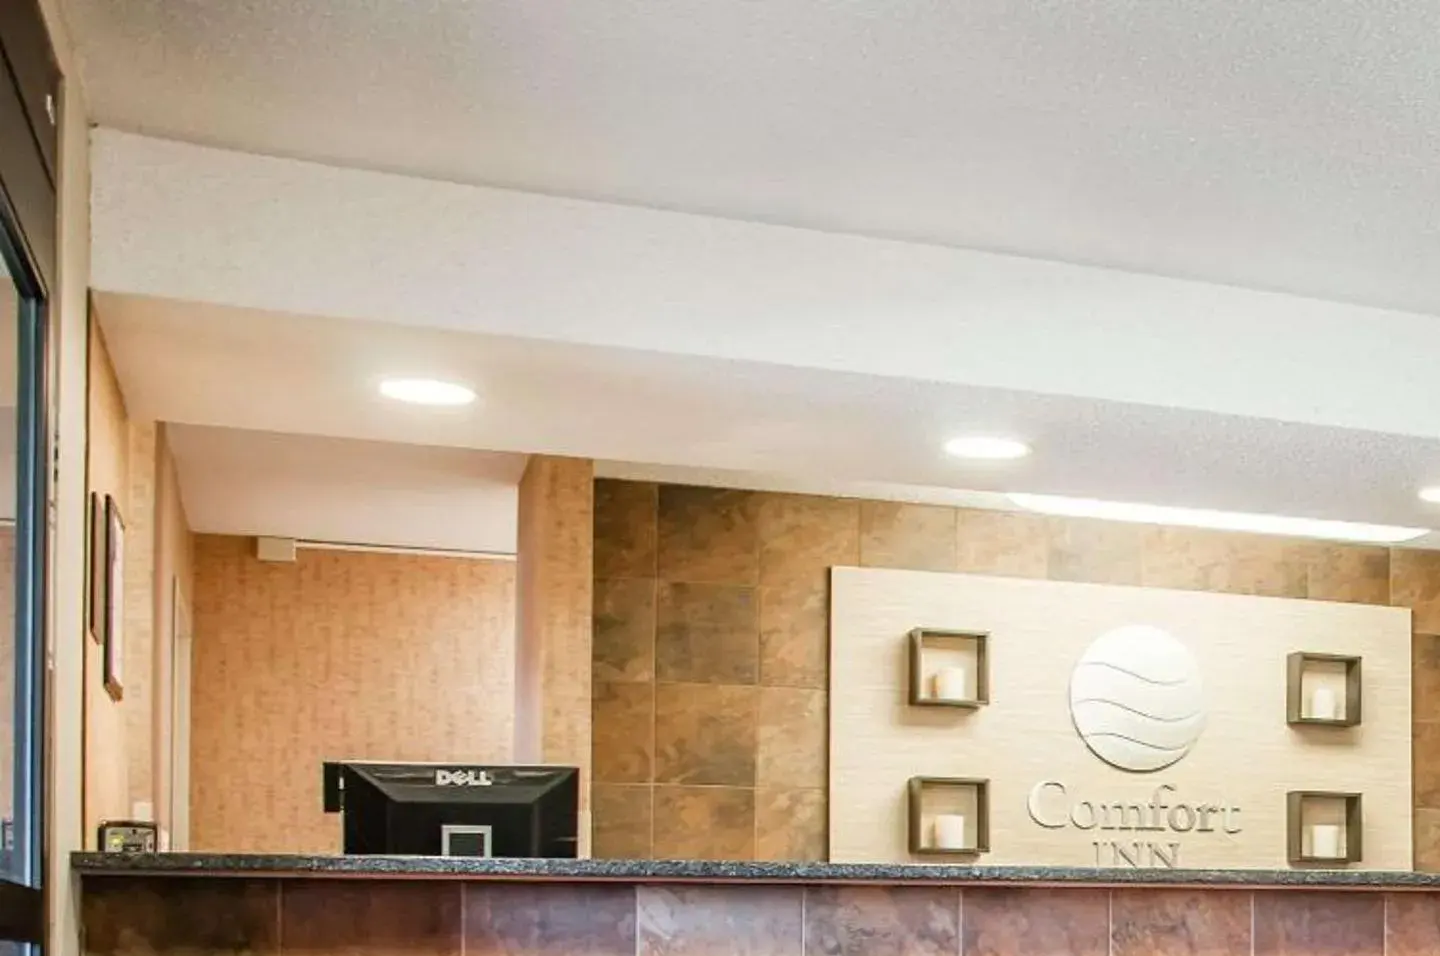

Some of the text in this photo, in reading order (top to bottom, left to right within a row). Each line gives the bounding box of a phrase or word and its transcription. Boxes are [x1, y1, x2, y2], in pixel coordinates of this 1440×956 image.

[435, 769, 492, 786] DELL
[1027, 780, 1242, 834] Comfort
[1092, 841, 1181, 869] INN
